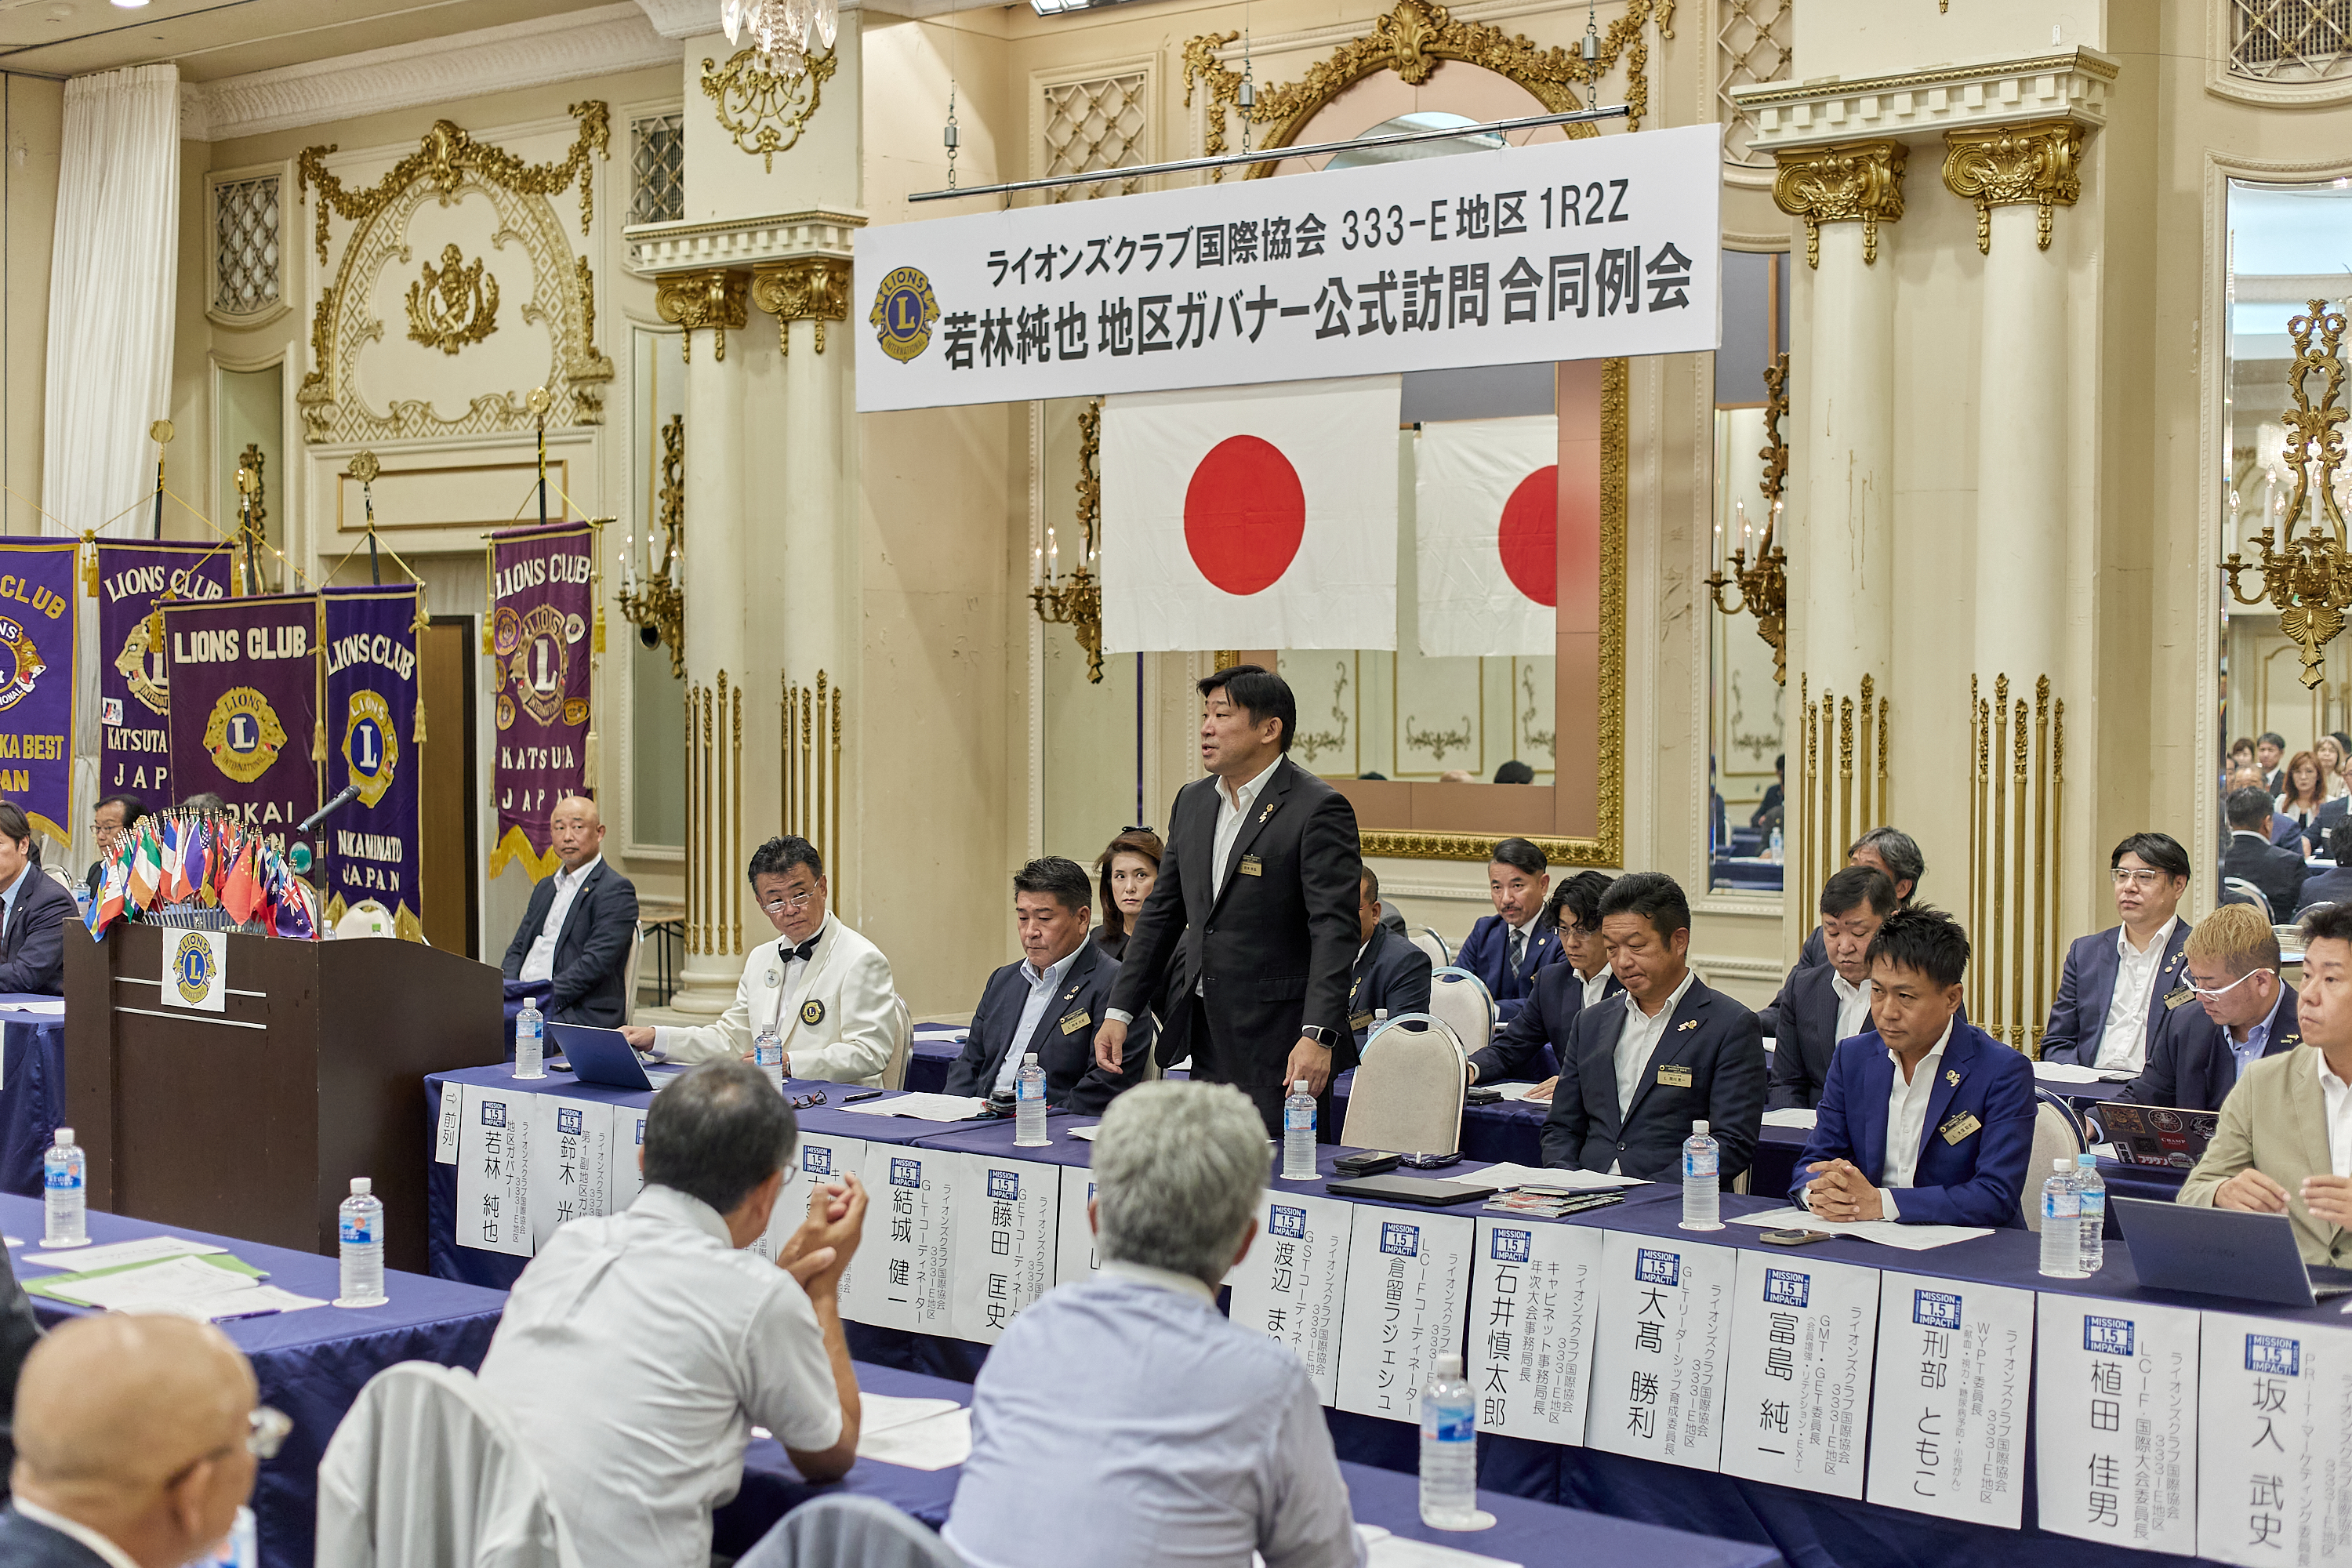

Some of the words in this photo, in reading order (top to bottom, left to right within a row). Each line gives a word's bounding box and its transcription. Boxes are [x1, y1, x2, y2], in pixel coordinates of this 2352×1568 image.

[987, 212, 1327, 288] ライオンズクラブ国際協会
[1539, 178, 1629, 230] 1R2Z
[884, 271, 925, 292] LIONS
[896, 296, 916, 330] L
[944, 301, 1089, 371] 若林純也
[1498, 241, 1693, 325] 合同例会
[885, 338, 925, 355] INTERNATIONAL
[103, 565, 165, 604] LIONS
[496, 557, 546, 601] LIONS
[550, 552, 591, 585] CLUB
[0, 574, 67, 619] CLUB
[173, 630, 240, 664] LIONS
[246, 625, 307, 660] CLUB
[371, 633, 416, 681] CLUB
[534, 638, 558, 691] L
[224, 693, 262, 713] LIONS
[352, 696, 385, 721] LIONS
[23, 734, 64, 760] BEST
[107, 726, 169, 753] KATSUTA
[231, 717, 256, 750] L
[359, 724, 378, 768] L
[114, 762, 168, 790] JAP
[342, 862, 401, 892] JAPAN
[182, 935, 208, 953] LIONS
[189, 954, 201, 980] L
[485, 1119, 503, 1127] IMPACT!
[490, 1109, 499, 1120] 1.5
[561, 1108, 579, 1117] MISSION
[565, 1116, 575, 1127] 1.5
[442, 1111, 456, 1146] 前列
[561, 1126, 579, 1134] IMPACT!
[485, 1130, 502, 1180] 若林
[558, 1135, 577, 1185] 鈴木
[807, 1146, 828, 1156] MISSION
[812, 1154, 822, 1166] 1.5
[895, 1159, 917, 1168] MISSION
[807, 1164, 827, 1174] IMPACT!
[894, 1178, 916, 1187] IMPACT!
[900, 1167, 911, 1178] 1.5
[993, 1171, 1015, 1180] MISSION
[992, 1189, 1014, 1200] IMPACT!
[998, 1179, 1009, 1191] 1.5
[483, 1192, 499, 1243] 純也
[891, 1187, 913, 1243] 結城
[1276, 1206, 1301, 1217] MISSION
[1282, 1215, 1294, 1228] 1.5
[991, 1200, 1013, 1256] 藤田
[1274, 1226, 1299, 1238] IMPACT!
[1388, 1223, 1414, 1235] MISSION
[1393, 1232, 1407, 1246] 1.5
[1497, 1229, 1526, 1240] MISSION
[1385, 1244, 1412, 1256] IMPACT!
[1496, 1250, 1524, 1261] IMPACT!
[1504, 1239, 1519, 1252] 1.5
[1643, 1249, 1675, 1262] MISSION
[887, 1258, 909, 1303] 健一
[1270, 1240, 1296, 1294] 渡辺
[1641, 1272, 1672, 1285] IMPACT!
[1650, 1260, 1666, 1274] 1.5
[1772, 1269, 1804, 1283] MISSION
[985, 1272, 1008, 1330] 匡史
[1769, 1293, 1802, 1307] IMPACT!
[1779, 1280, 1795, 1295] 1.5
[1921, 1290, 1955, 1304] MISSION
[1315, 1235, 1339, 1376] ライオンズクラブ国際協会
[1929, 1301, 1946, 1317] 1.5
[1405, 1238, 1431, 1417] LCIFコーディネーター
[1519, 1259, 1543, 1383] 年次大会事務局長
[1919, 1315, 1954, 1329] IMPACT!
[2091, 1316, 2128, 1330] MISSION
[1483, 1263, 1520, 1428] 石井慎太郎
[1533, 1261, 1560, 1416] キャビネット事務局長
[1562, 1264, 1588, 1414] ライオンズクラブ国際協会
[1765, 1311, 1799, 1382] 富島
[2090, 1341, 2127, 1355] IMPACT!
[2100, 1327, 2118, 1343] 1.5
[2253, 1335, 2292, 1349] MISSION
[1664, 1265, 1693, 1457] GLTリーダーシップ育成委員長
[1697, 1283, 1722, 1438] ライオンズクラブ国際協会
[1920, 1330, 1950, 1390] 刑部
[2252, 1361, 2292, 1376] IMPACT!
[2263, 1347, 2282, 1363] 1.5
[1809, 1314, 1831, 1446] GMT・GET委員長
[1970, 1321, 1991, 1417] WYPT委員長
[1838, 1306, 1862, 1465] ライオンズクラブ国際協会
[2090, 1358, 2123, 1433] 植田
[1627, 1370, 1659, 1439] 勝利
[1994, 1330, 2018, 1494] ライオンズクラブ国際協会
[2251, 1376, 2288, 1454] 坂入
[1758, 1398, 1791, 1456] 純一
[2166, 1352, 2183, 1520] ライオンズクラブ国際協会
[1913, 1406, 1942, 1497] ともこ
[2133, 1341, 2152, 1541] LCIF・国際大会委員長
[2088, 1453, 2120, 1529] 佳男
[2249, 1474, 2285, 1550] 武史
